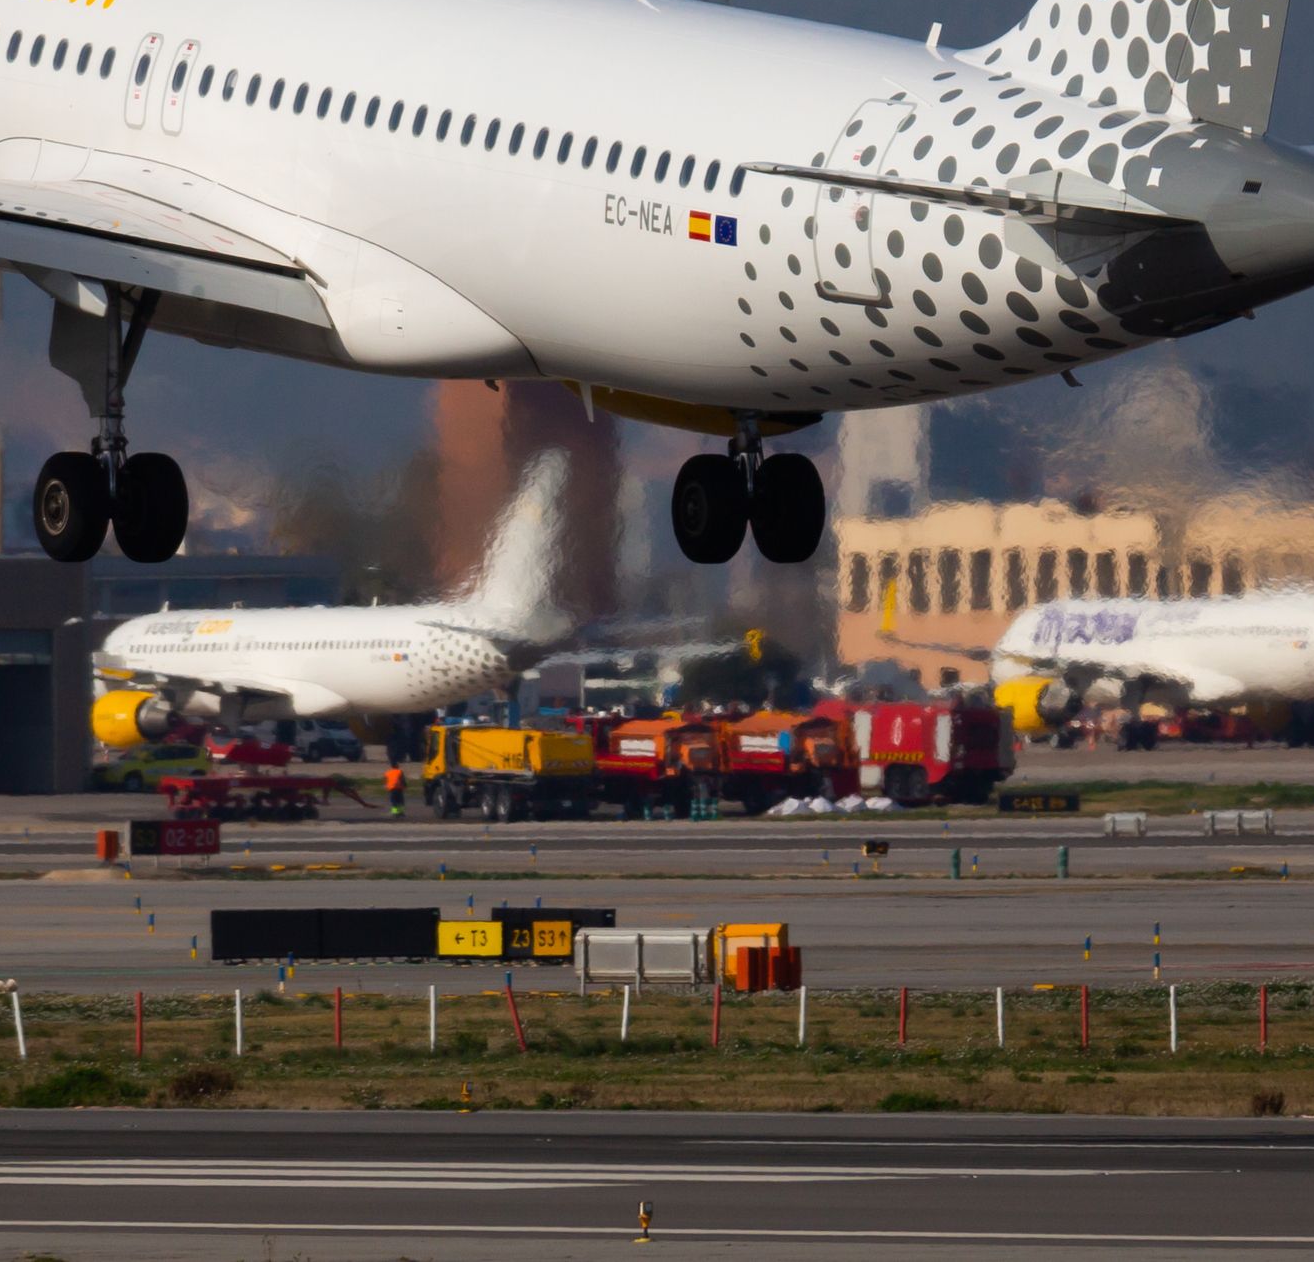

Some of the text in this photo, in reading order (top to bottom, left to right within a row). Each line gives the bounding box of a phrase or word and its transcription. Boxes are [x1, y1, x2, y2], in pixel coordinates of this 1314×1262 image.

[604, 193, 673, 236] EC-NEA
[165, 827, 215, 848] 02-20
[471, 929, 488, 947] T3
[511, 929, 556, 948] Z3 S3
